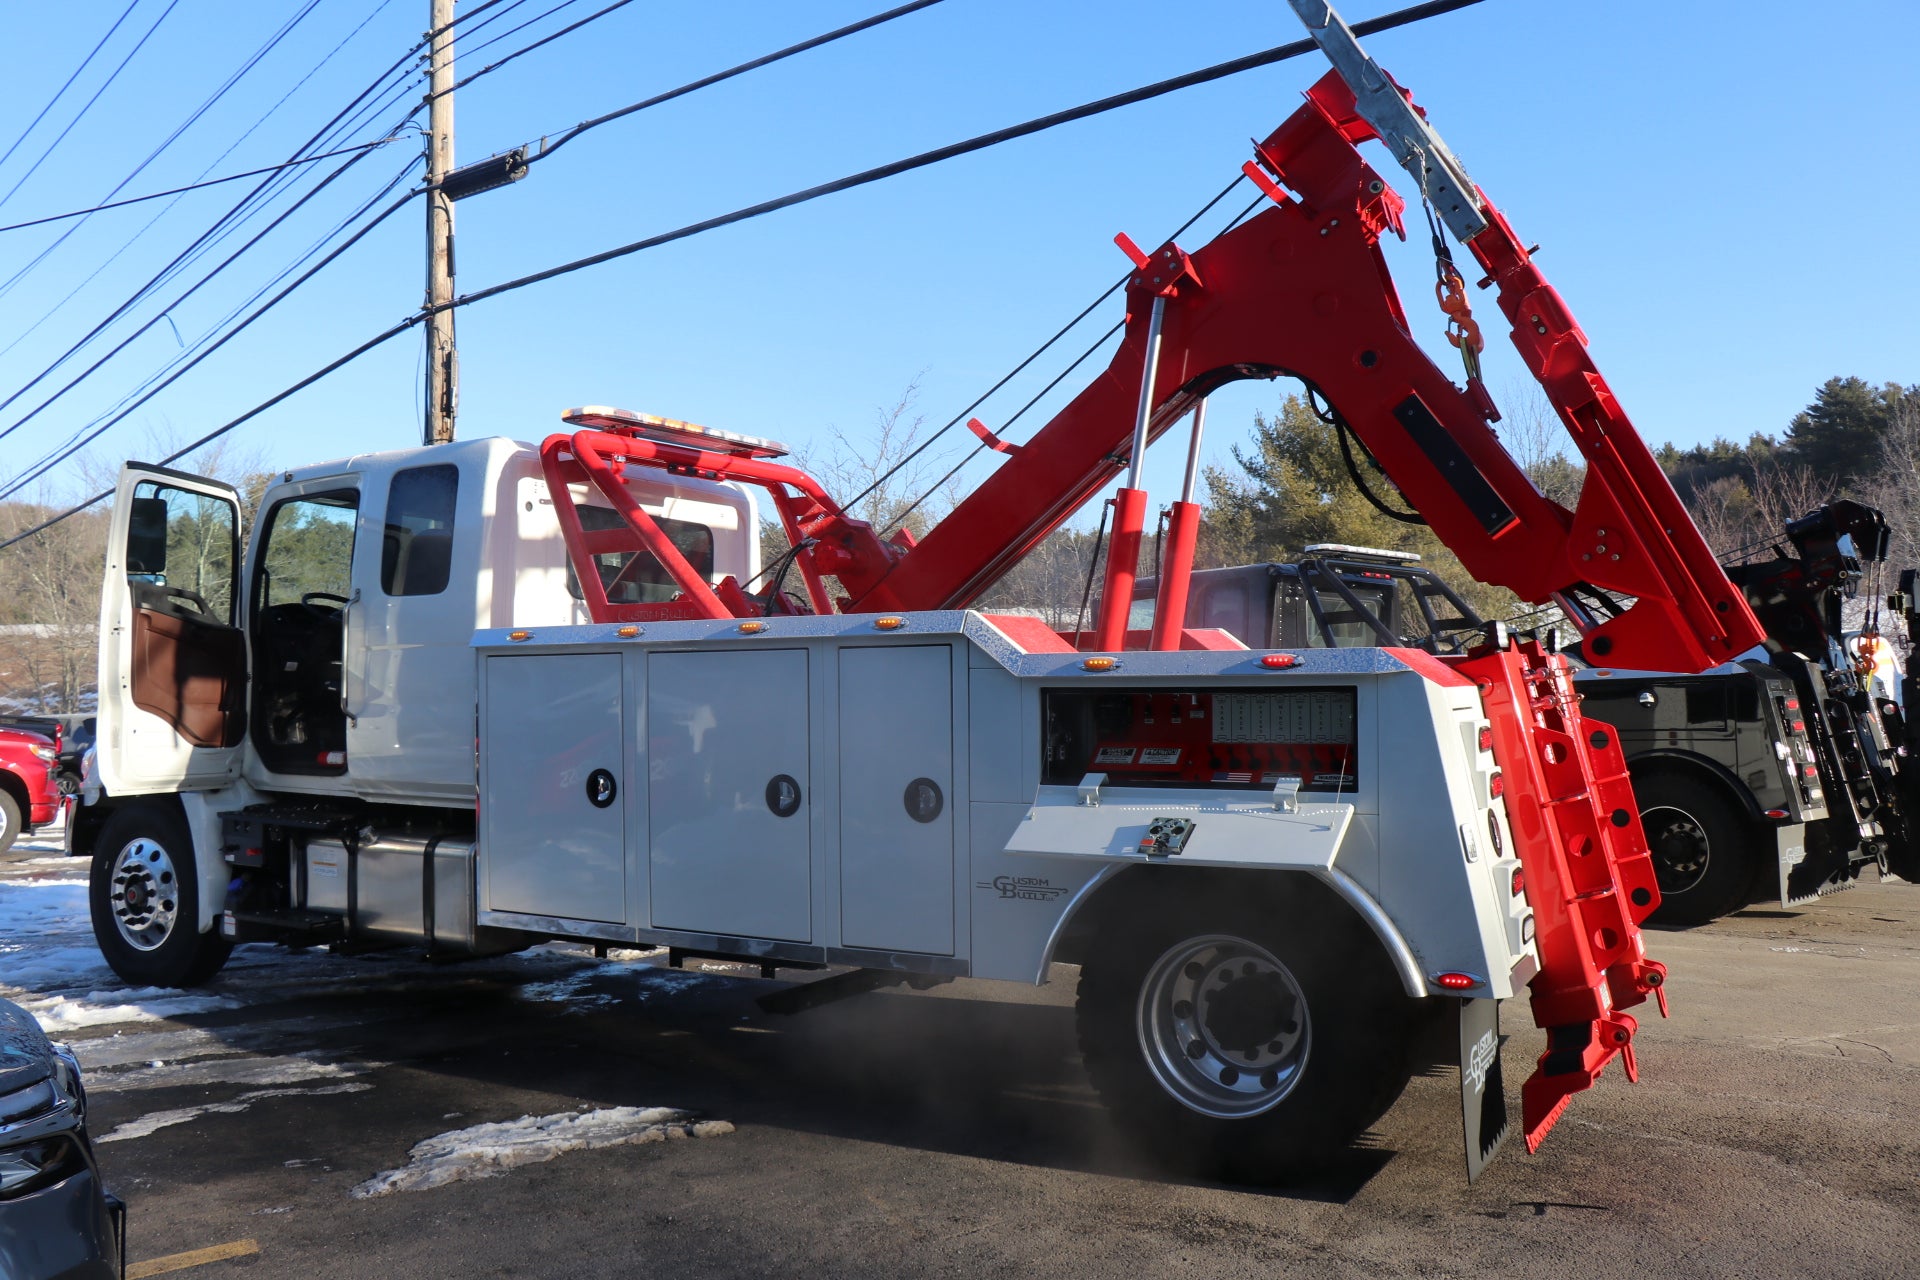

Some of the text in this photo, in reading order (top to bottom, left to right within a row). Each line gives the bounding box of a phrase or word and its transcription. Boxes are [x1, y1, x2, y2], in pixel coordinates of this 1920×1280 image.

[993, 875, 1049, 891] CUSTOM
[999, 882, 1046, 901] BUILT
[1470, 1029, 1492, 1078] CUSTOM
